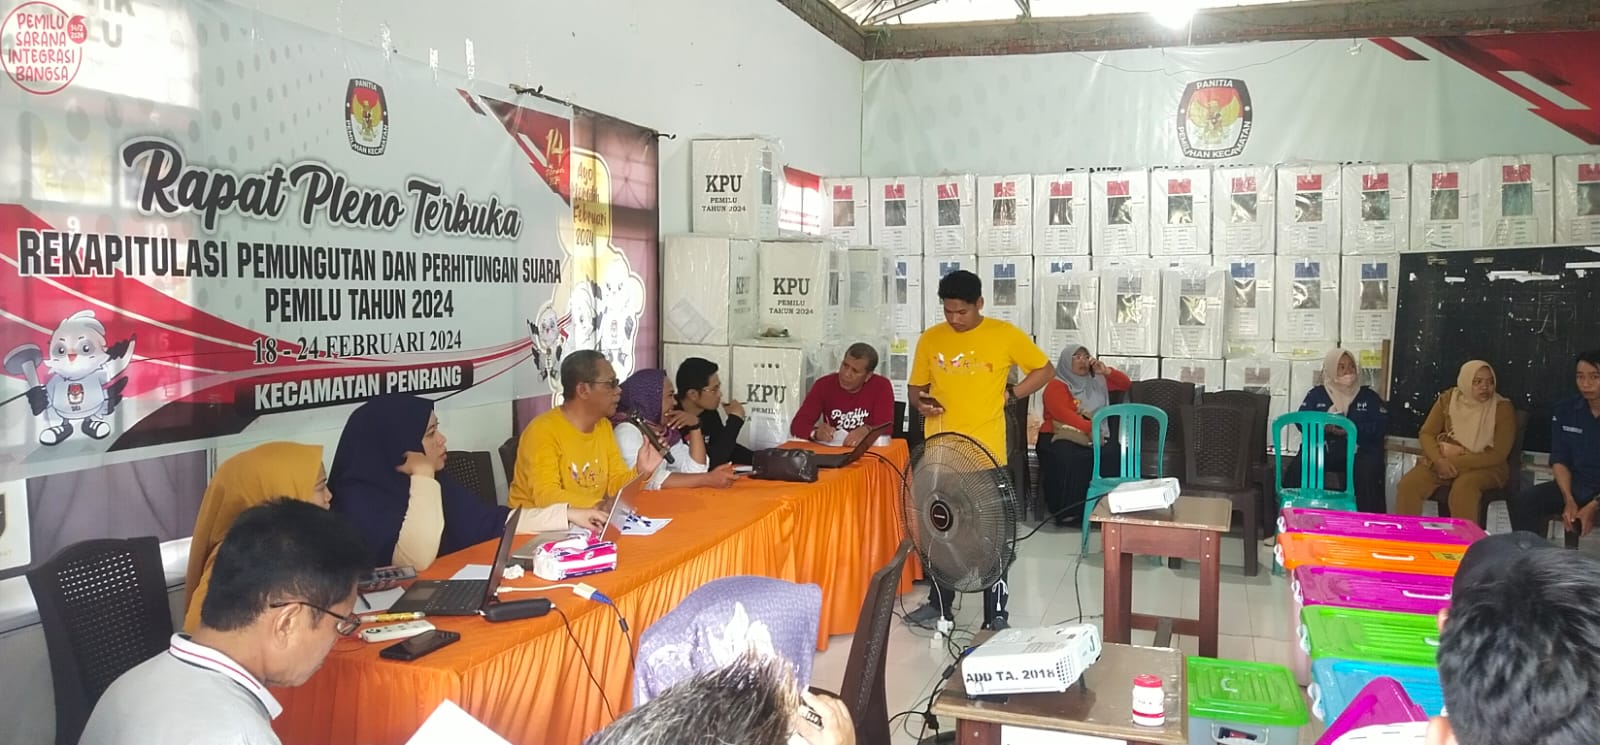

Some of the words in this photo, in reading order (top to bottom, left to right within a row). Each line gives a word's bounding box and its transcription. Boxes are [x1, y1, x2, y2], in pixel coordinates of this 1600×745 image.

[16, 13, 65, 30] PEMILU
[16, 31, 66, 47] SARANA
[8, 48, 75, 64] INTEGRASI
[16, 65, 68, 82] BANGSA
[355, 80, 377, 91] PANITIA
[1196, 80, 1233, 89] PANITIA
[545, 128, 565, 167] 14
[1212, 121, 1251, 158] KECAMATAN
[122, 140, 287, 231] Rapat
[289, 164, 404, 227] Pleno
[407, 180, 521, 238] Terbuka
[705, 174, 743, 193] KPU
[573, 203, 607, 226] Februari
[575, 228, 594, 247] 2024
[19, 230, 227, 278] REKAPITULASI
[237, 242, 376, 281] PEMUNGUTAN
[382, 250, 417, 281] DAN
[422, 252, 518, 283] PERHITUNGAN
[522, 258, 562, 283] SUARA
[773, 277, 811, 296] KPU
[265, 288, 341, 322] PEMILU
[348, 289, 406, 320] TAHUN
[412, 290, 454, 318] 2024
[768, 307, 794, 315] TAHUN
[253, 337, 277, 364] 18
[297, 335, 319, 361] 24
[326, 331, 426, 358] FEBRUARI
[430, 329, 462, 350] 2024
[255, 373, 380, 410] KECAMATAN
[386, 365, 462, 394] PENRANG
[746, 383, 787, 404] KPU
[751, 407, 781, 415] PEMIL
[830, 407, 870, 421] Pemilu
[836, 418, 865, 430] 2024
[966, 671, 993, 684] ADD
[1021, 667, 1056, 680] 2018
